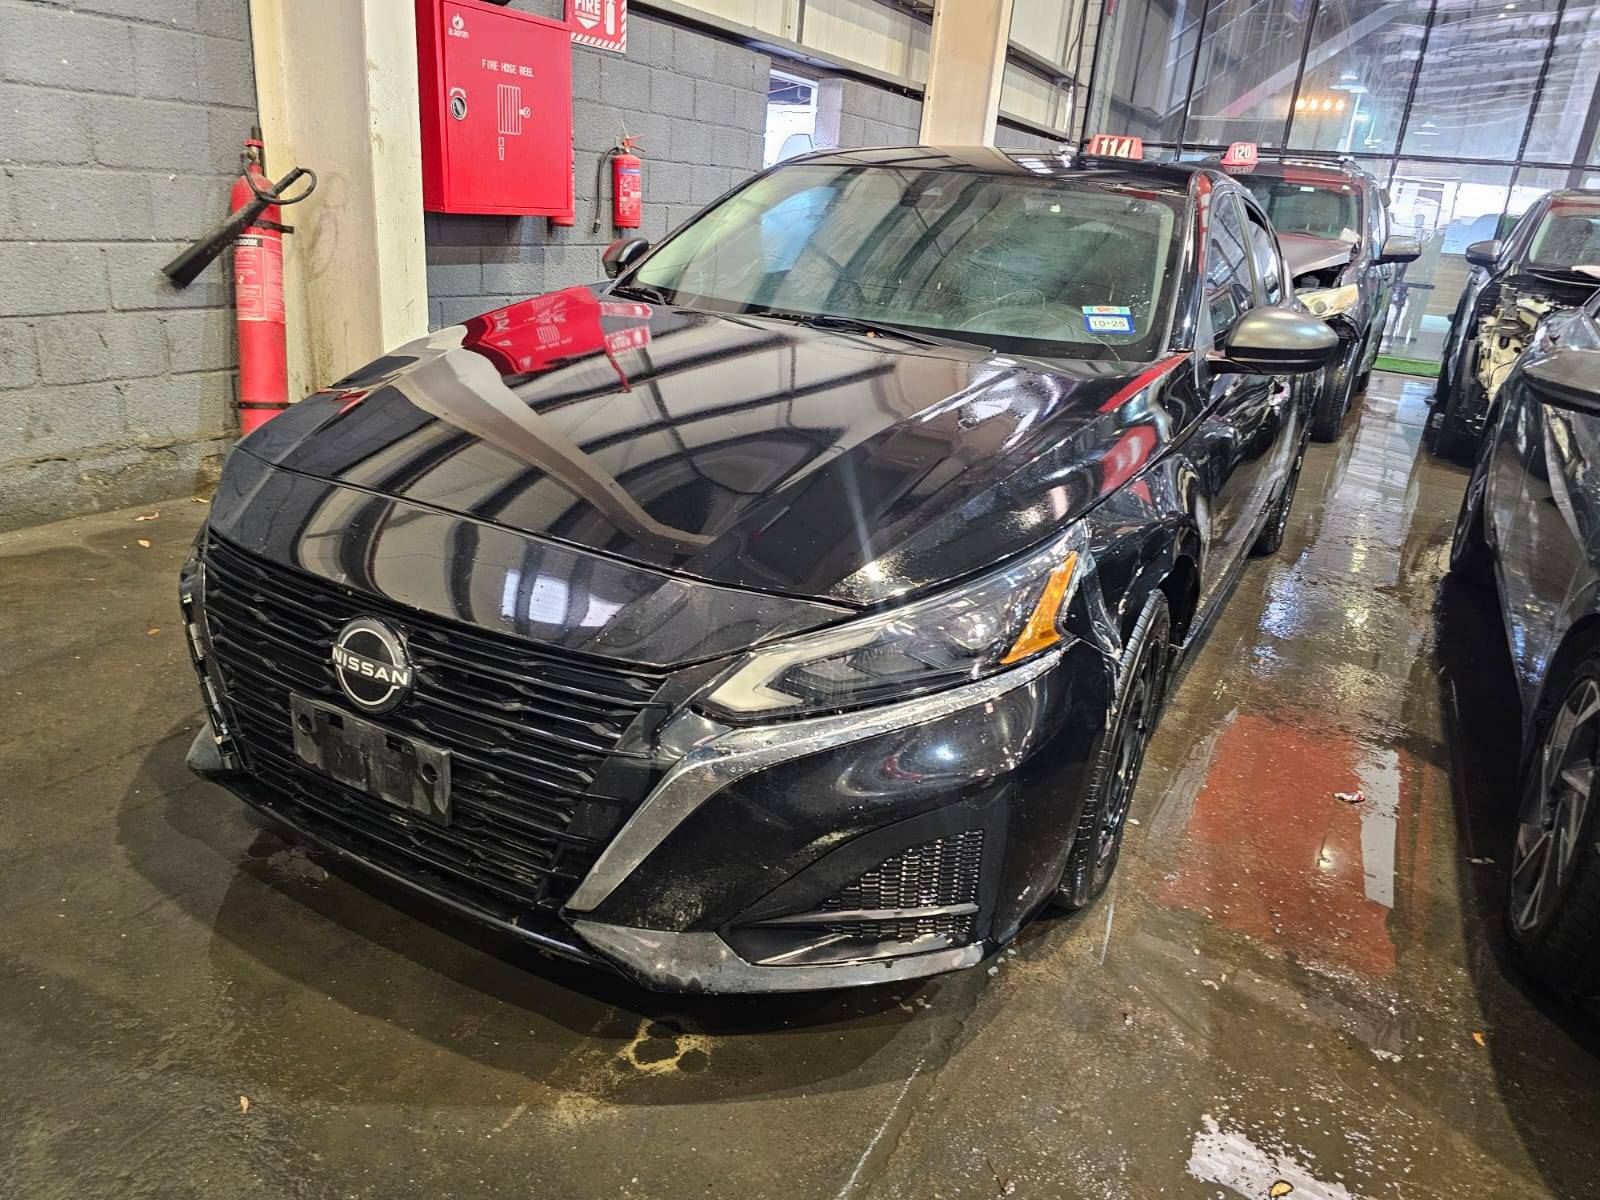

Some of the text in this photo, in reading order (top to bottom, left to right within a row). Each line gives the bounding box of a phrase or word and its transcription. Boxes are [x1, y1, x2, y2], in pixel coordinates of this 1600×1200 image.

[575, 0, 600, 15] FIRE
[481, 59, 499, 71] FIRE
[501, 62, 518, 75] HOSE
[1101, 138, 1132, 158] 114
[1234, 145, 1251, 160] 120
[332, 646, 408, 686] NISSAN
